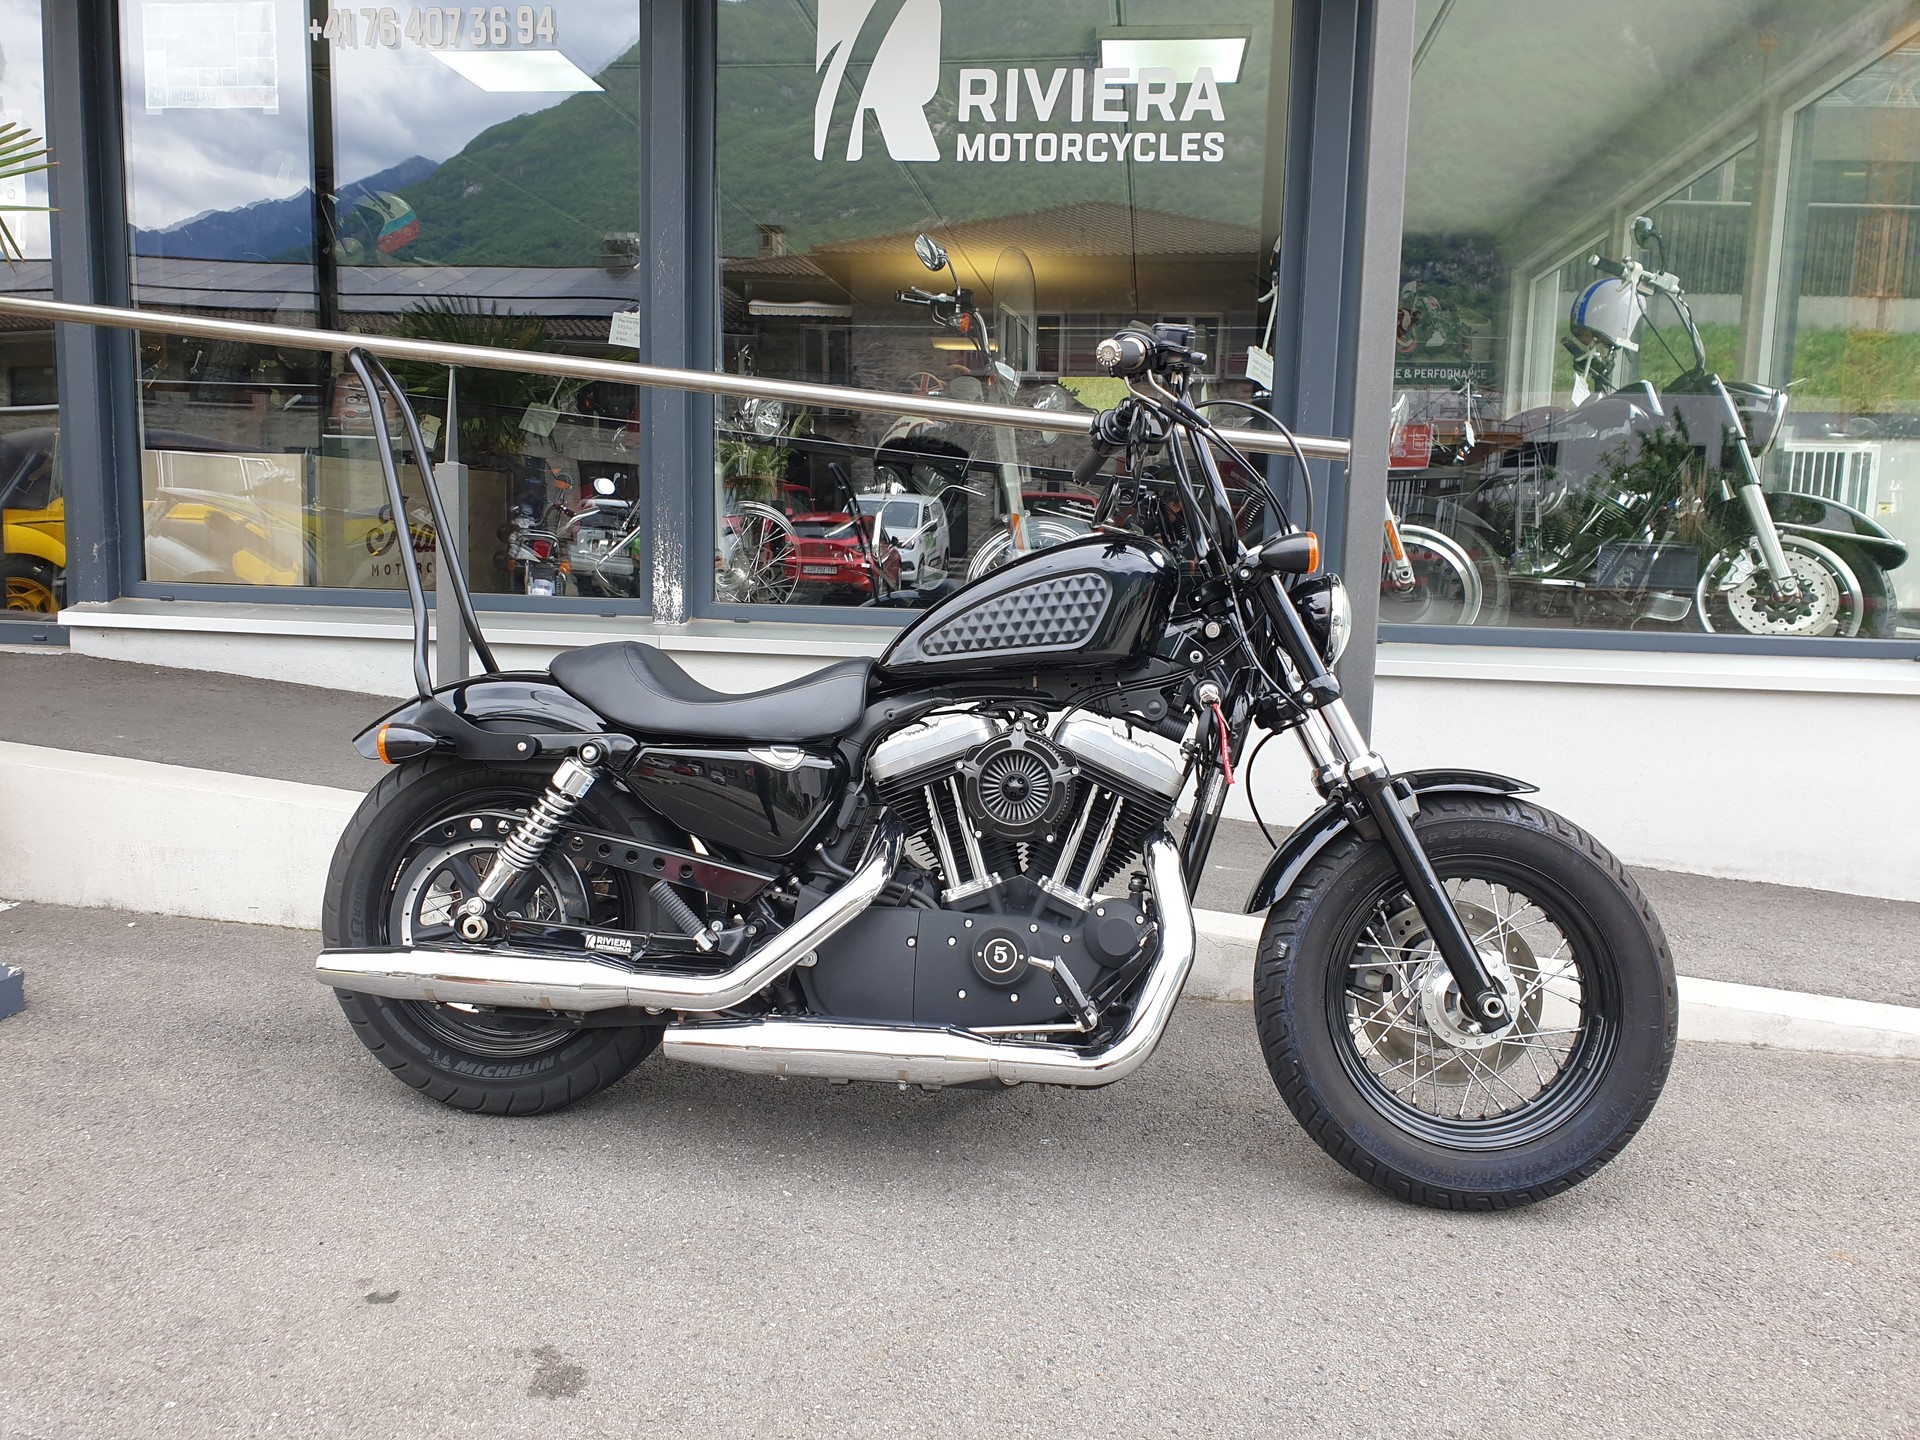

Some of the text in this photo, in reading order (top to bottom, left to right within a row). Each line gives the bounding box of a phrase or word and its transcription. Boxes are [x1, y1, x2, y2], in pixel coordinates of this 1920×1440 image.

[309, 5, 555, 47] +41 76 407 36 94
[958, 66, 1226, 123] RIVIERA
[956, 131, 1226, 163] MOTORCYCLES
[1414, 368, 1488, 380] PERFORMANCE
[596, 935, 633, 949] RIVIERA
[993, 945, 1008, 964] 5
[453, 1054, 556, 1078] MICHELIN
